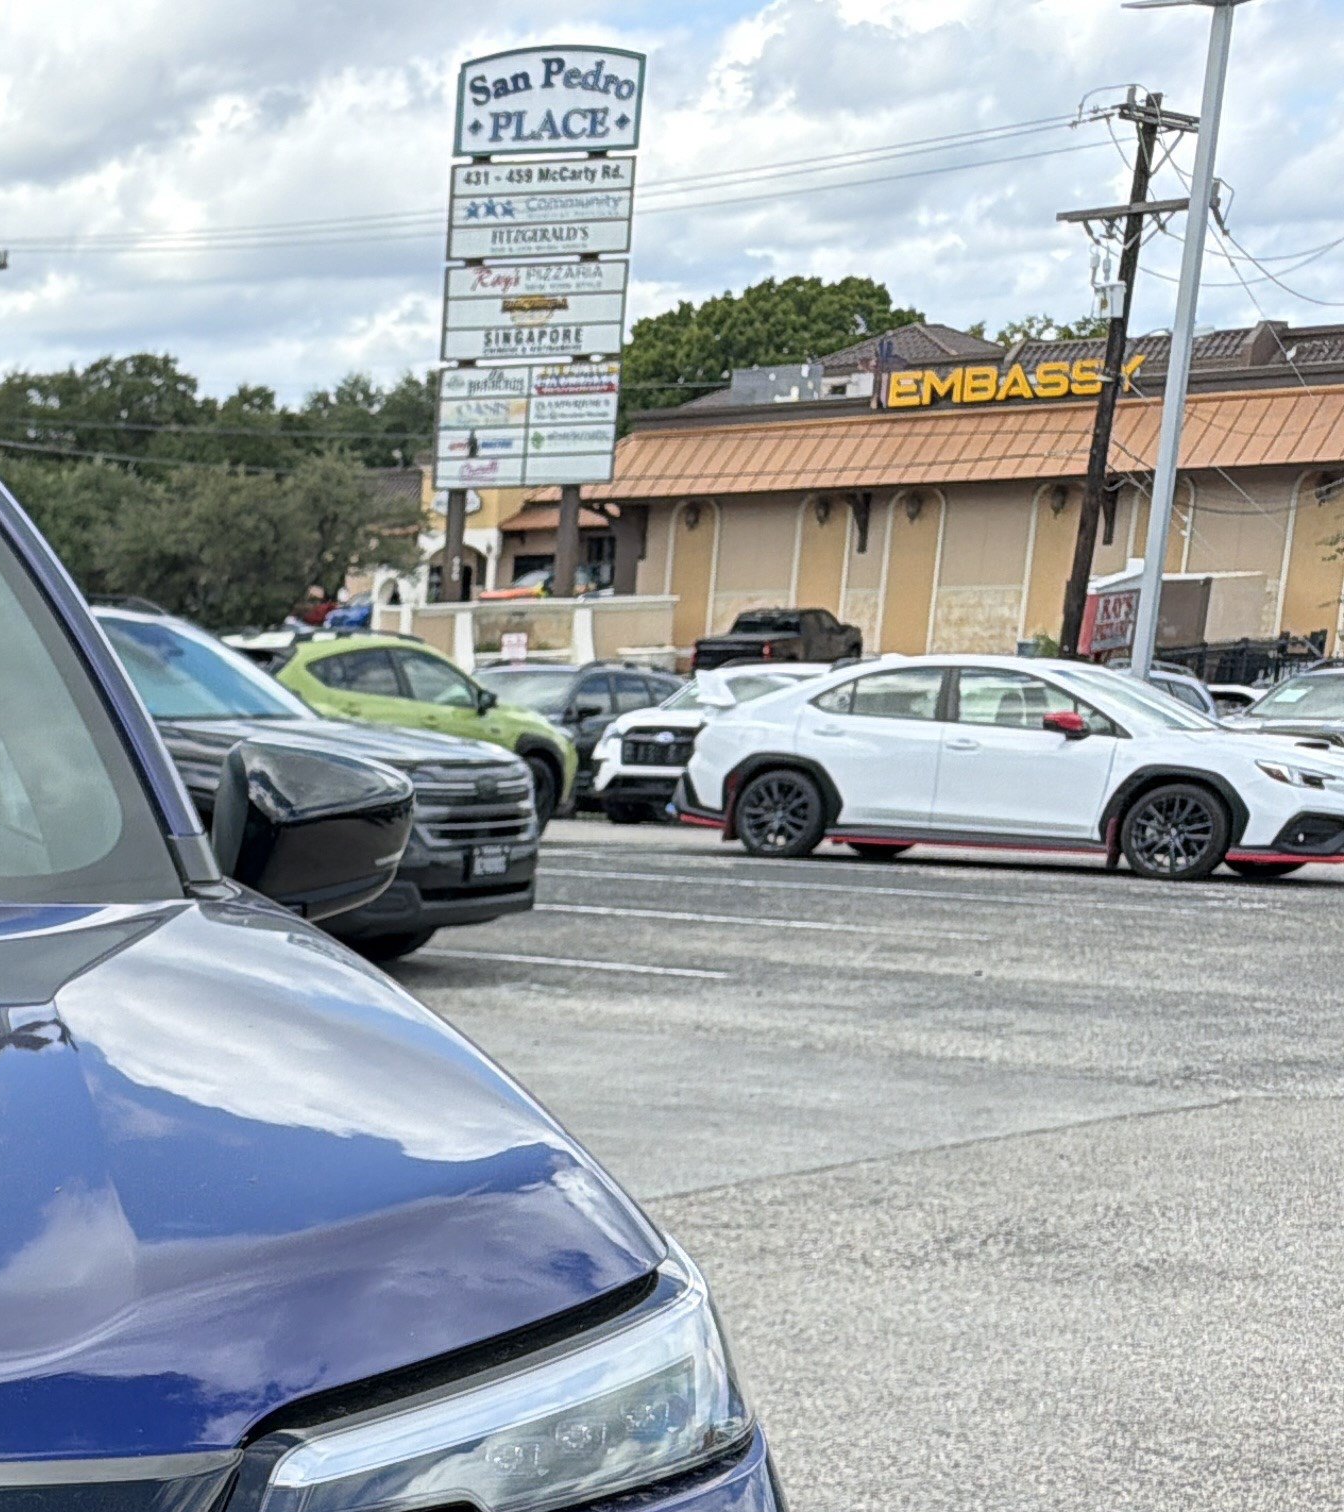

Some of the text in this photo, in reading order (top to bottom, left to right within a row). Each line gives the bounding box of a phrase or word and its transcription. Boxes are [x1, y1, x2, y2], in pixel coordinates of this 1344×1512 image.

[469, 57, 635, 107] San Pedro
[488, 106, 610, 143] PLACE
[537, 166, 598, 185] McCarty
[601, 164, 625, 181] Rd.
[483, 327, 584, 347] SINGAPORE
